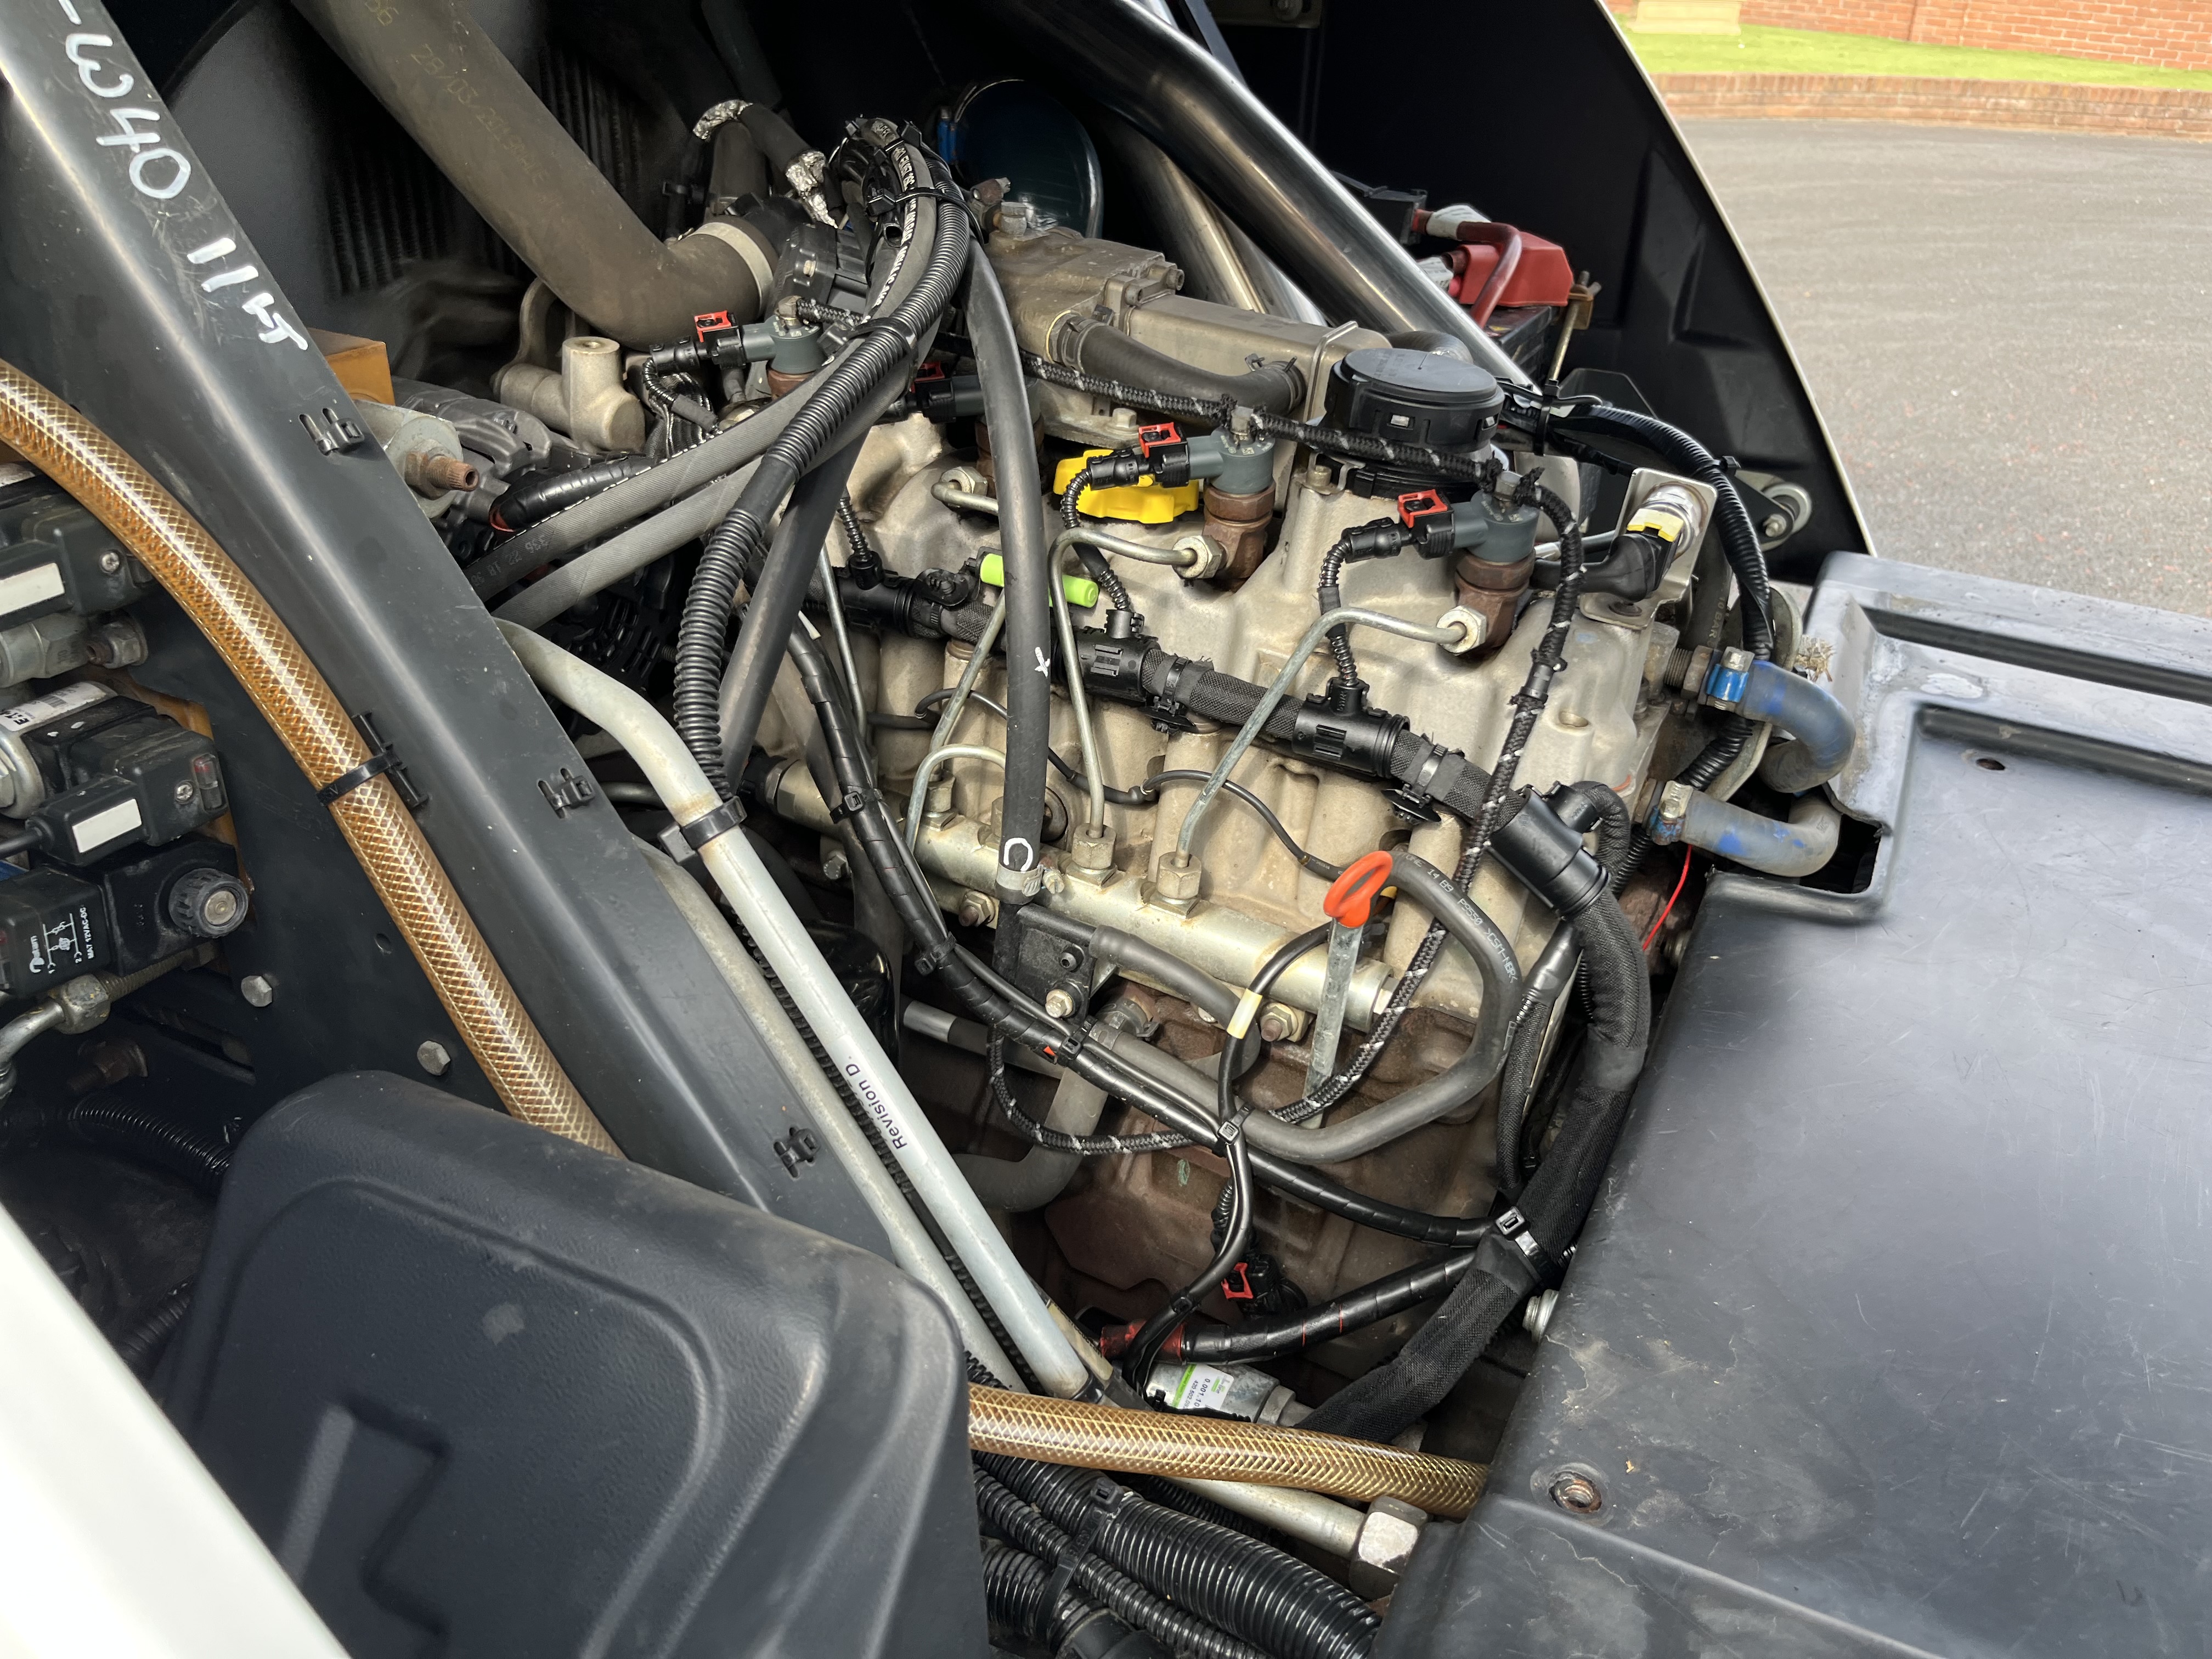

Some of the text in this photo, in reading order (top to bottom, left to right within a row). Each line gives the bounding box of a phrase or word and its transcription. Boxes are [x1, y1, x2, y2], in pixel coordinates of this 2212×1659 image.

[1708, 612, 1723, 638] BAR
[858, 1079, 908, 1150] Revision
[1194, 1378, 1211, 1408] 0.001.10
